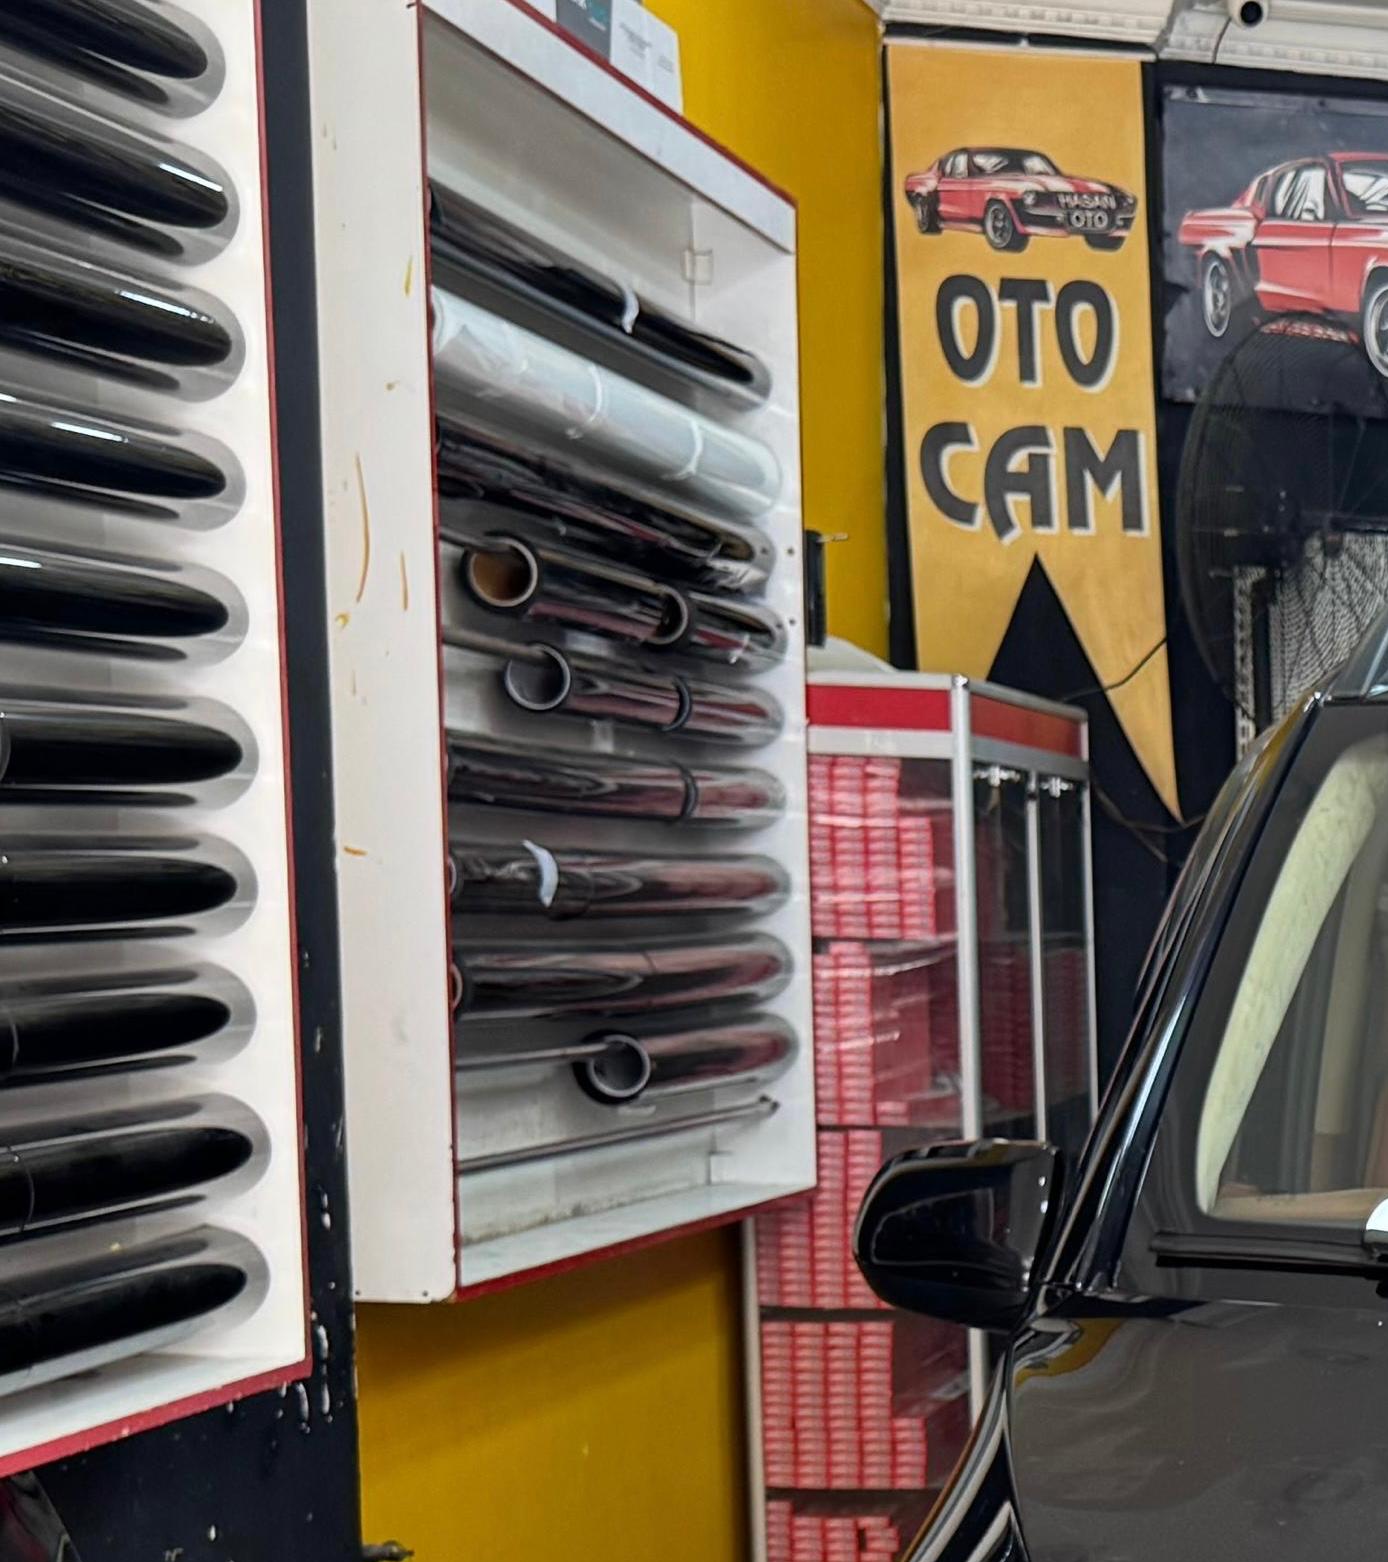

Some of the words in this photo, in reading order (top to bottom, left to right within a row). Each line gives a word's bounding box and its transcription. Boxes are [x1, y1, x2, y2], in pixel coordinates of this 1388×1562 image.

[1070, 209, 1109, 228] OTO
[934, 273, 1119, 391] OTO
[918, 421, 1149, 543] CAM
